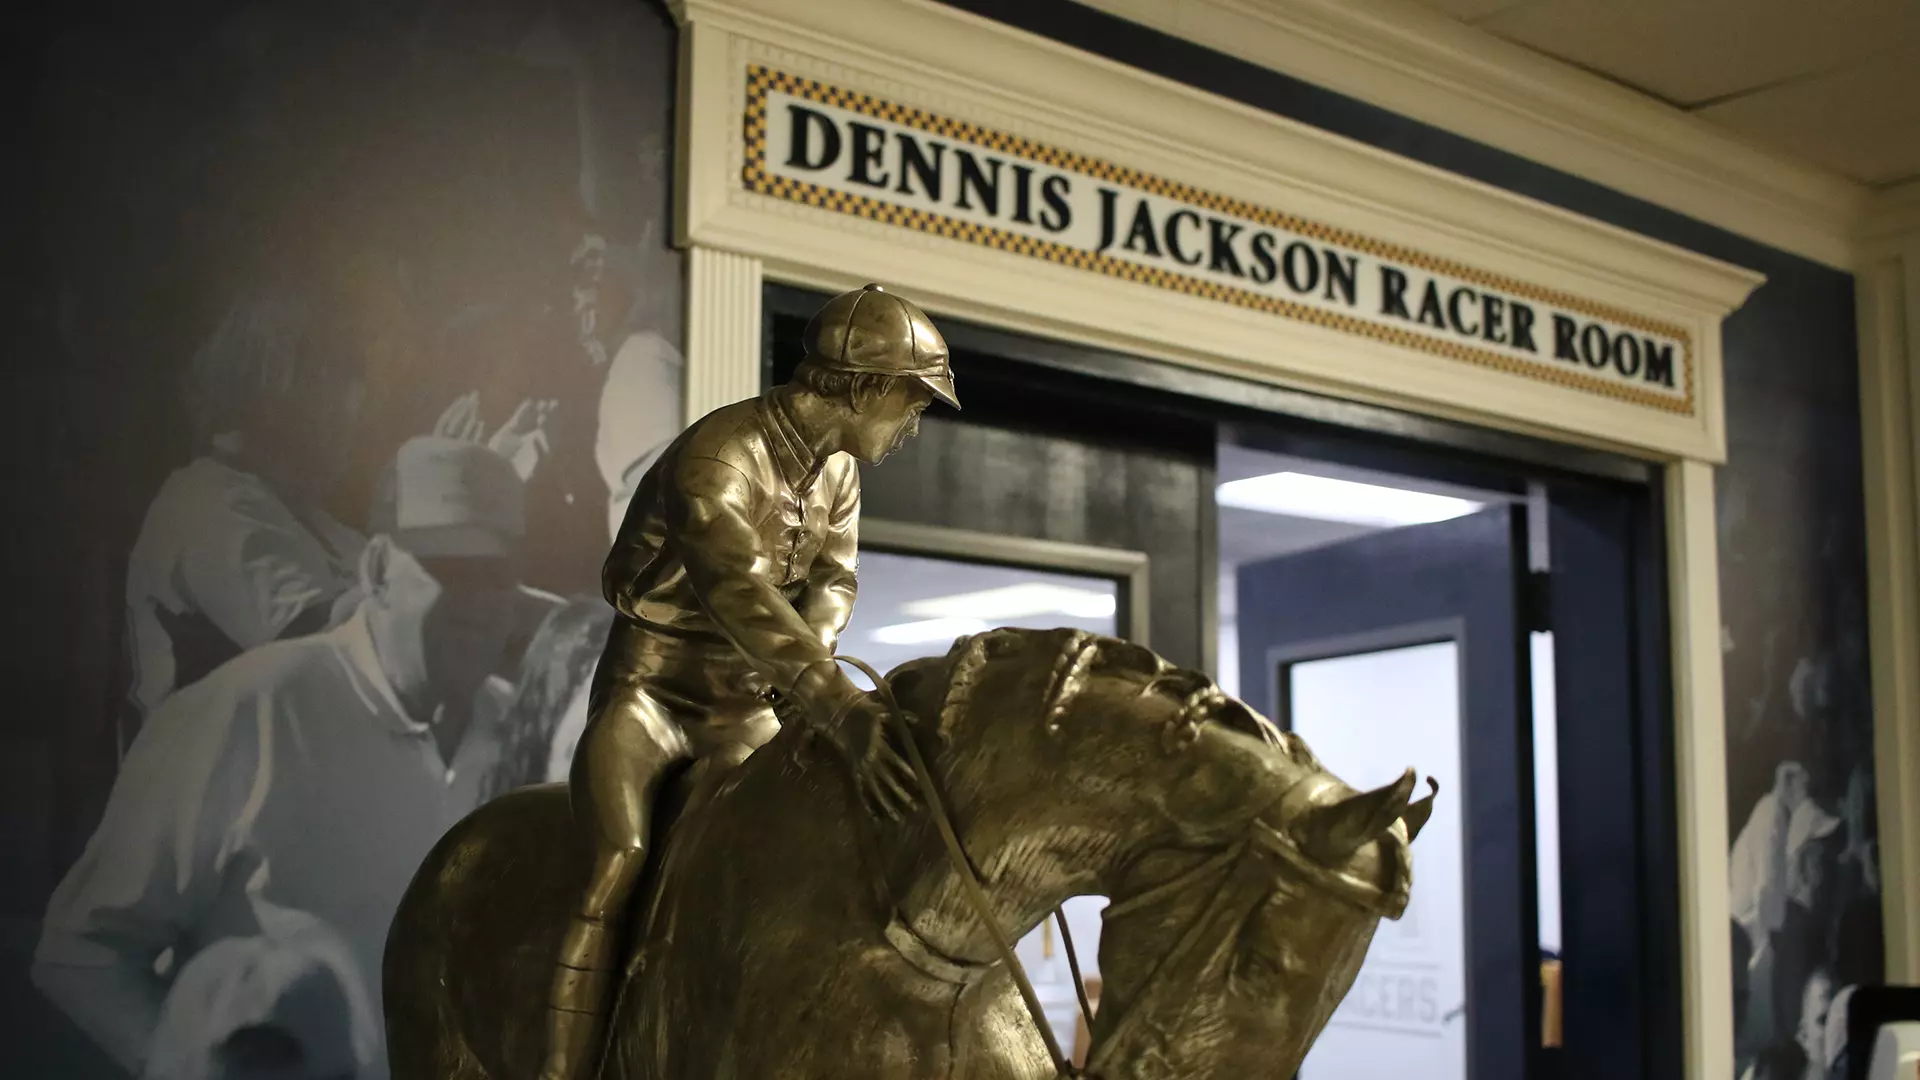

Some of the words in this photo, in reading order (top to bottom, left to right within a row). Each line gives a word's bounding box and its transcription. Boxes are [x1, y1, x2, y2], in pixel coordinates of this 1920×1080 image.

[783, 103, 1073, 233] DENNIS
[1096, 187, 1359, 306] JACKSON
[1379, 265, 1538, 353] RACER
[1551, 312, 1675, 388] ROOM
